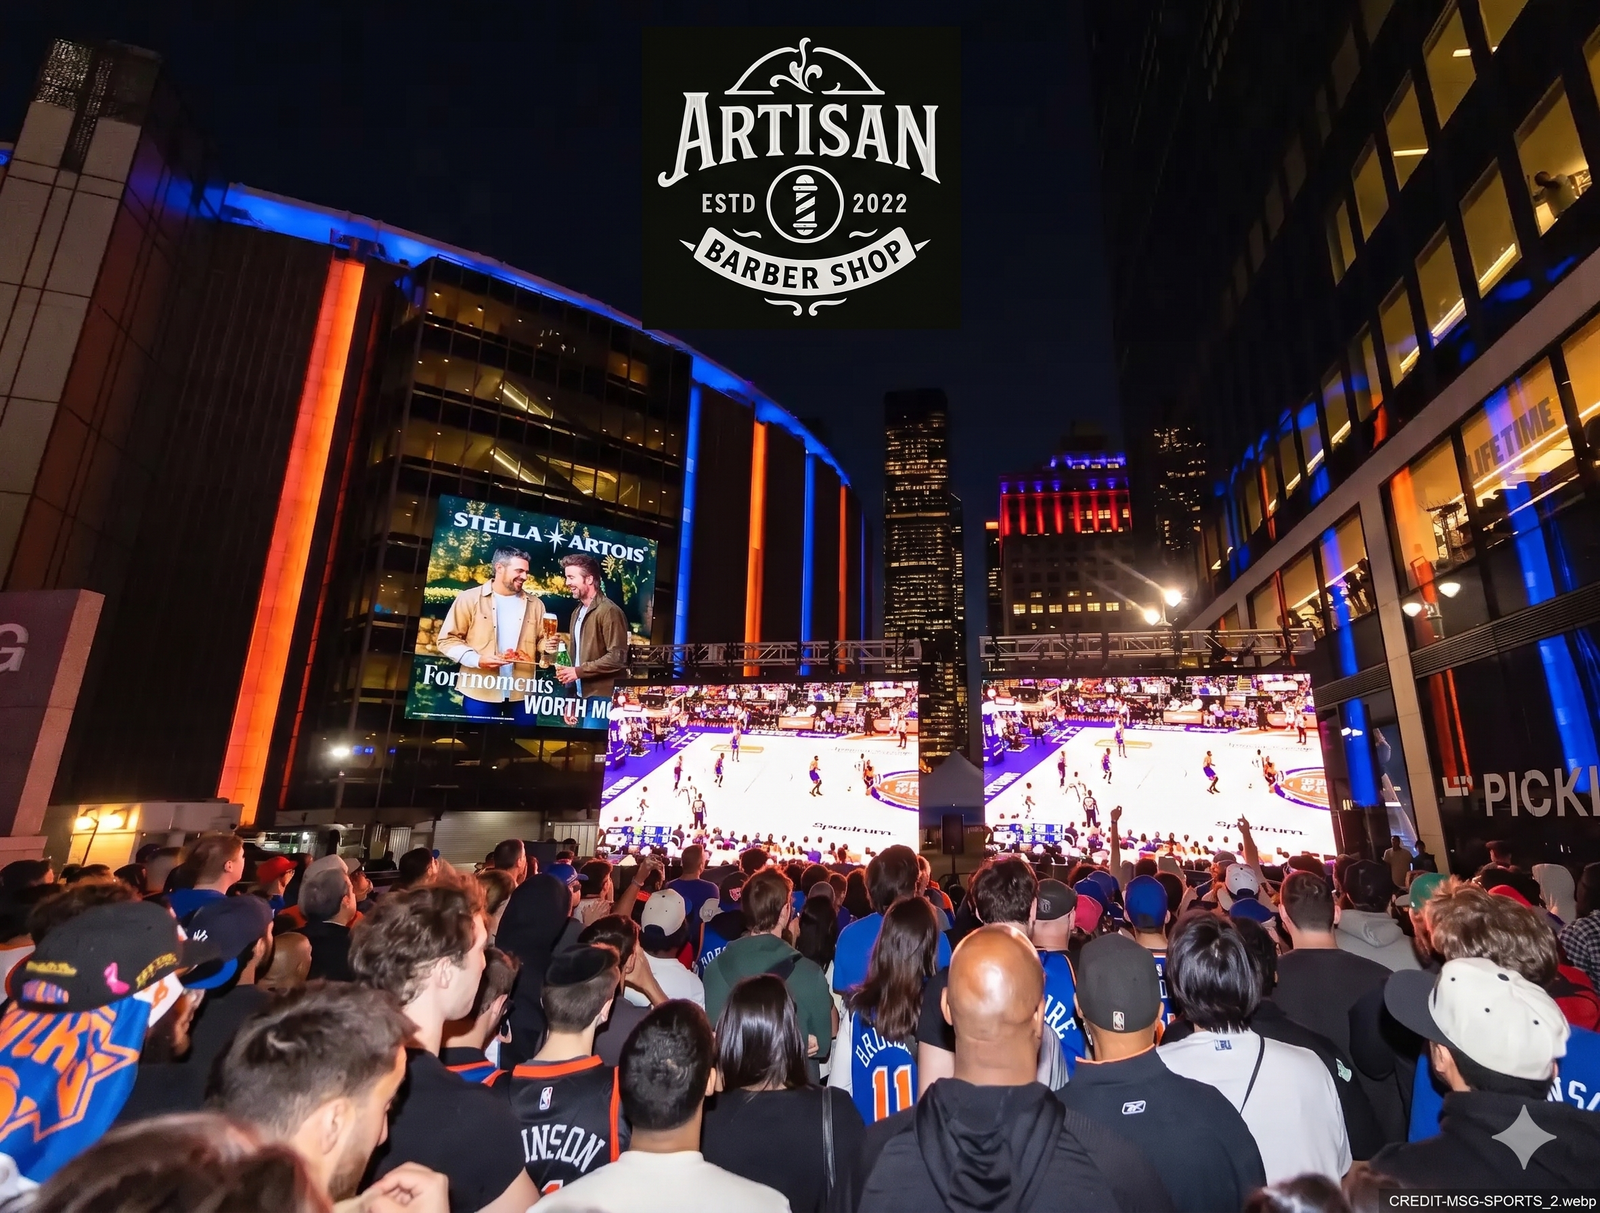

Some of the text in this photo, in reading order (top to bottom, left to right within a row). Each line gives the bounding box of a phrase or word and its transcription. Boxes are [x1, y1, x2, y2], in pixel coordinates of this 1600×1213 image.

[453, 511, 542, 543] STELLA
[524, 694, 588, 718] WORTH
[872, 1064, 914, 1122] 11
